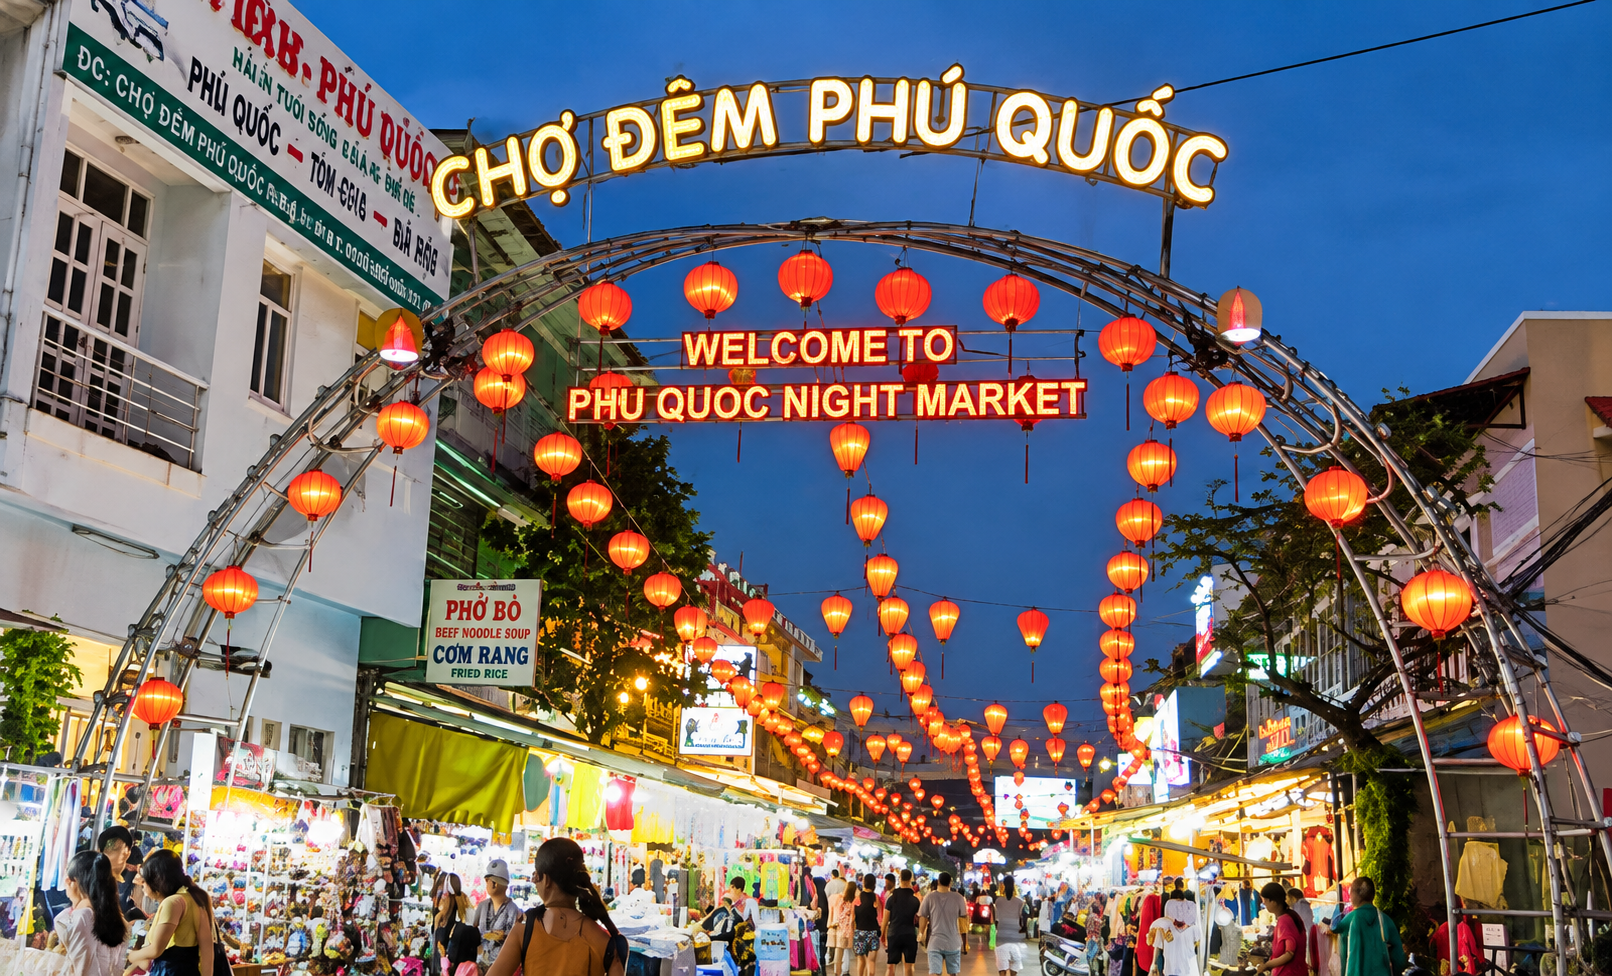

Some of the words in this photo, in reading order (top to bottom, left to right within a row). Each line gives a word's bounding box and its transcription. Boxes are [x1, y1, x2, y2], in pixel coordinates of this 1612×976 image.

[77, 45, 111, 86] ĐC:
[116, 74, 155, 120] CHỢ
[228, 155, 264, 196] QUỐC
[431, 110, 578, 219] CHỢ
[601, 75, 777, 173] ĐÊM
[808, 63, 968, 148] PHÚ
[995, 83, 1229, 208] QUỐC
[683, 329, 888, 366] WELCOME
[899, 328, 955, 362] TO
[568, 386, 645, 421] PHU
[656, 386, 770, 422] QUOC
[783, 383, 904, 419] NIGHT
[916, 380, 1087, 418] MARKET
[445, 592, 489, 621] PHỞ
[492, 594, 521, 621] BÒ
[435, 627, 459, 638] BEEF
[462, 627, 502, 639] NOODLE
[504, 628, 531, 639] SOUP
[433, 643, 474, 664] CƠM
[477, 646, 529, 665] RANG
[451, 668, 481, 678] FRIED
[484, 668, 508, 679] RICE
